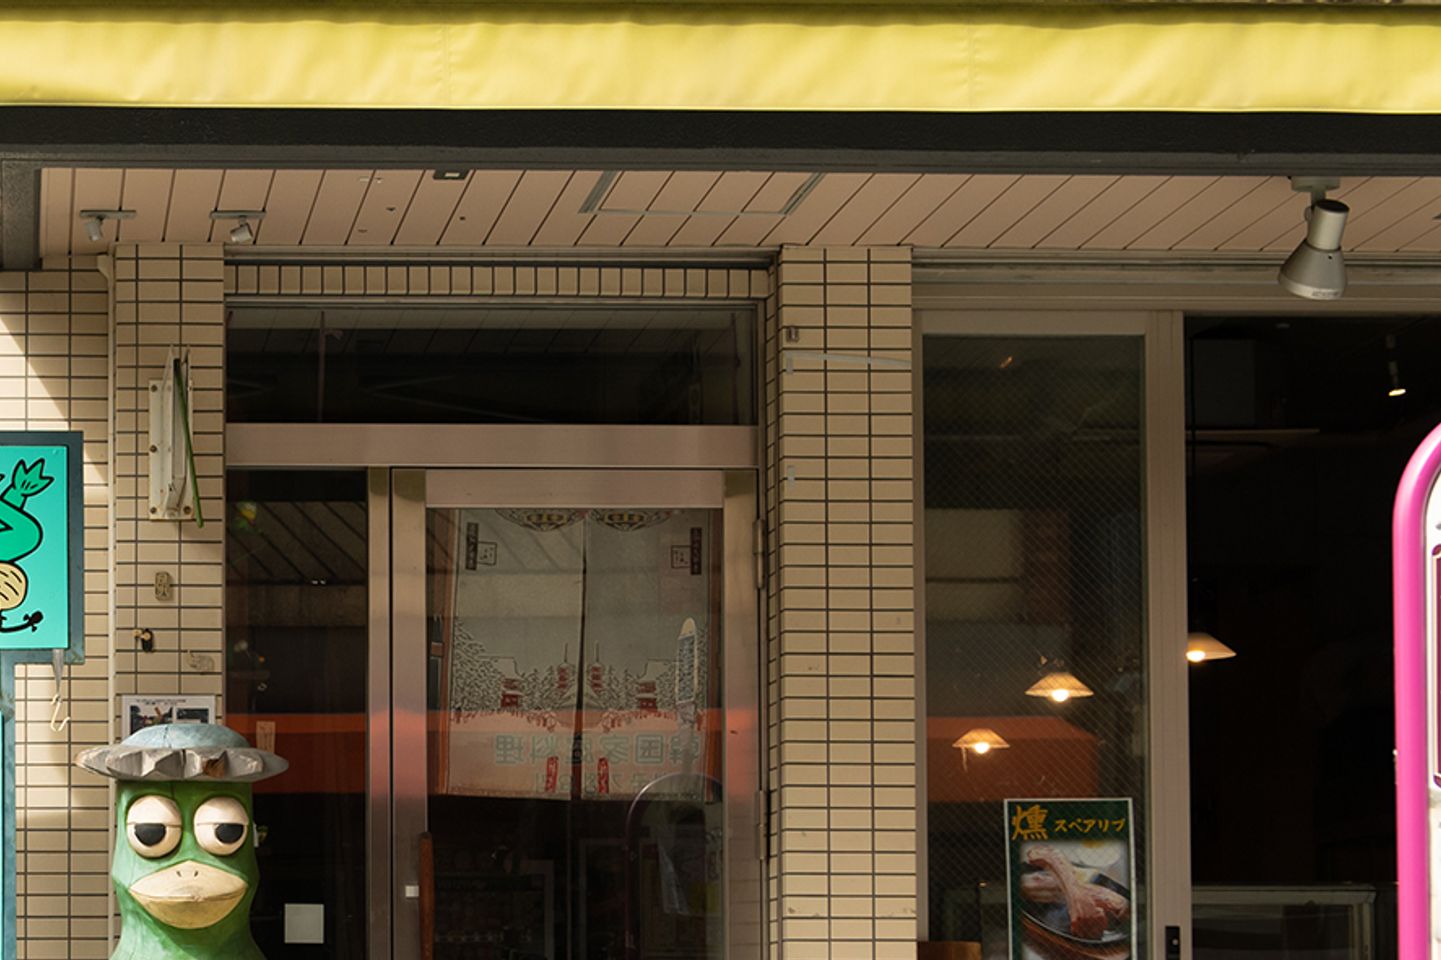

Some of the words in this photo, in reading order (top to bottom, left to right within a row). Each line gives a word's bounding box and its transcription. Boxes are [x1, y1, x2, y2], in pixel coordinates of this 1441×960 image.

[1054, 818, 1127, 833] スペアリブ
